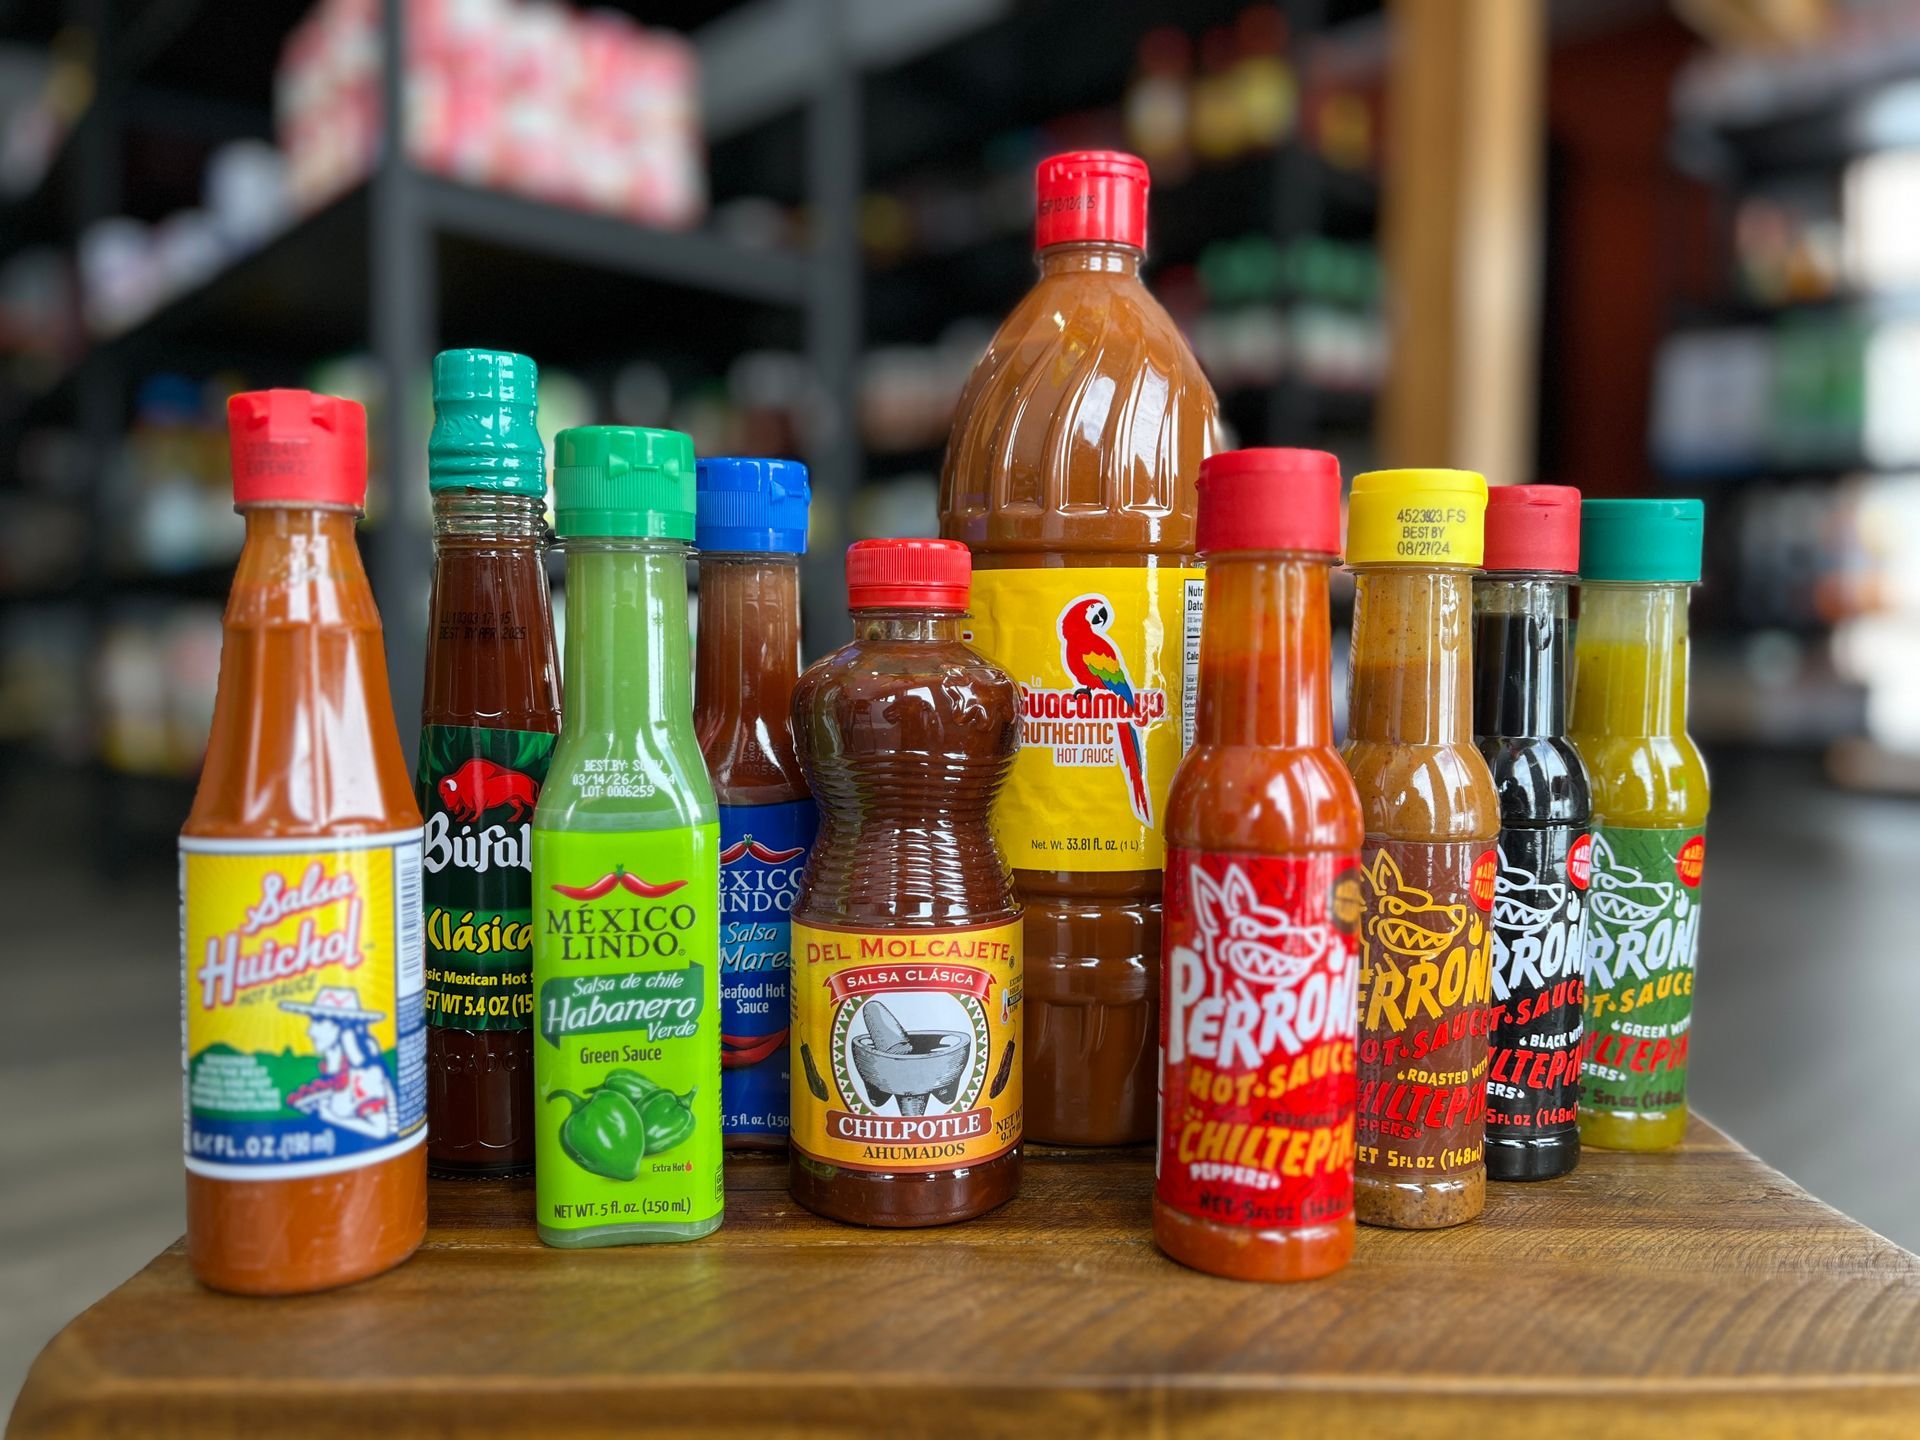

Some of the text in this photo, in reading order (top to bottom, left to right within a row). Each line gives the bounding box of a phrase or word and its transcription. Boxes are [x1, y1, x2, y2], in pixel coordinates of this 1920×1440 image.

[1402, 526, 1446, 539] BEST BY
[440, 626, 460, 640] BEST
[503, 626, 527, 640] 2025
[1021, 722, 1115, 745] AUTHENTIC
[583, 760, 609, 772] BEST
[1056, 748, 1115, 764] HOT SAUCE
[581, 785, 656, 798] LOT: 0006259
[424, 811, 532, 874] Búfal
[1031, 837, 1139, 853] Net. Wt. 33.81 fl. oz. (1 L)
[243, 861, 356, 934] Salsa
[719, 890, 795, 913] INDO
[427, 907, 533, 954] Clásica
[546, 903, 696, 935] MÉXICO
[725, 921, 778, 944] Salsa
[197, 898, 363, 1010] Huichol
[562, 931, 679, 960] LINDO
[807, 937, 1011, 965] DEL MOLCAJETE
[443, 971, 498, 987] Mexican
[502, 973, 527, 986] Hot
[572, 971, 684, 998] Salsa de chile
[846, 967, 975, 988] SALSA CLÁSICA
[239, 974, 317, 1006] HOT SAUCE
[765, 983, 786, 998] Hot
[1618, 971, 1693, 1014] SAUCE
[425, 989, 533, 1018] ET WT 5.4 OZ (15
[736, 999, 769, 1014] Sauce
[1515, 979, 1584, 1026] SAUCE
[547, 995, 697, 1034] Habanero
[648, 1020, 697, 1042] Verde
[1360, 1036, 1403, 1067] OT
[1412, 1008, 1489, 1060] SAUCE
[1530, 1032, 1567, 1049] BLACK
[1621, 1021, 1668, 1039] GREEN
[580, 1045, 662, 1065] Green Sauce
[1190, 1042, 1355, 1107] HOT SAUCE
[1407, 1055, 1488, 1087] ROASTED WITH
[731, 1115, 738, 1127] 5
[740, 1113, 750, 1126] fl.
[752, 1116, 765, 1126] oz.
[838, 1113, 982, 1141] CHILPOTLE
[996, 1113, 1015, 1135] NET
[1358, 1117, 1413, 1140] PPERS
[1513, 1114, 1531, 1126] OZ
[863, 1142, 966, 1160] AHUMADOS
[1416, 1156, 1435, 1169] OZ
[652, 1162, 685, 1173] Extra Hot
[1189, 1161, 1269, 1190] PEPPERS
[554, 1197, 691, 1219] NET WT. 5 fl. oz. (150 mL)
